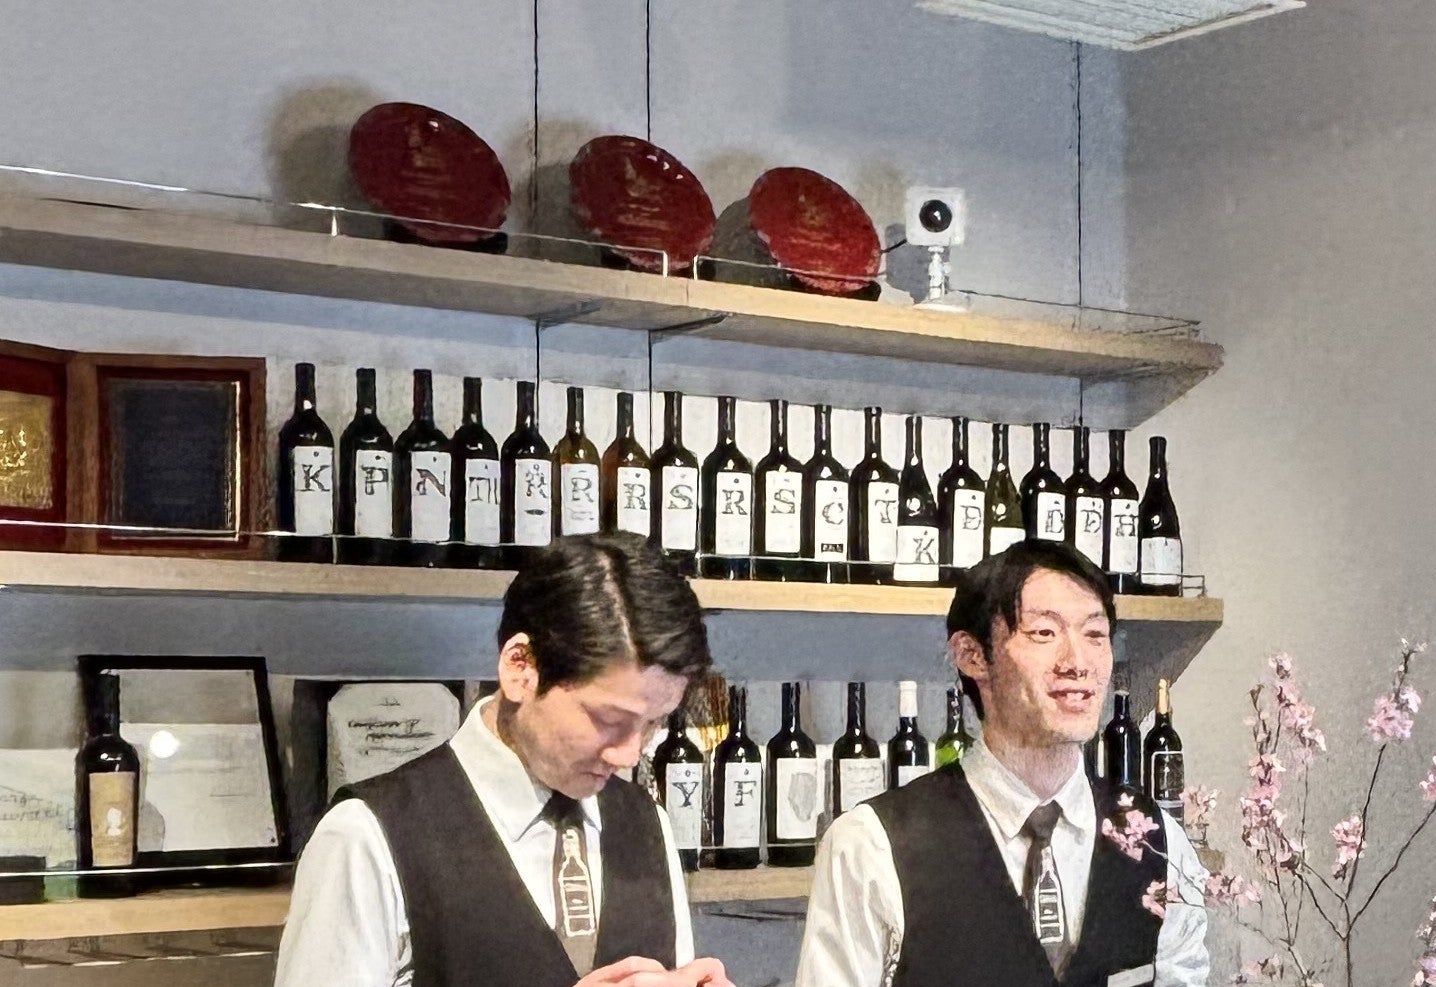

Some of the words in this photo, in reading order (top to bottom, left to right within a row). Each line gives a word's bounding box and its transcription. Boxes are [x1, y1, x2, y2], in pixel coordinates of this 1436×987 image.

[296, 463, 331, 492] K
[361, 465, 389, 496] P
[415, 468, 447, 498] N
[622, 482, 648, 511] R
[667, 484, 694, 510] S
[721, 489, 748, 516] R
[771, 488, 796, 514] S
[671, 781, 700, 808] Y
[733, 780, 757, 807] F
